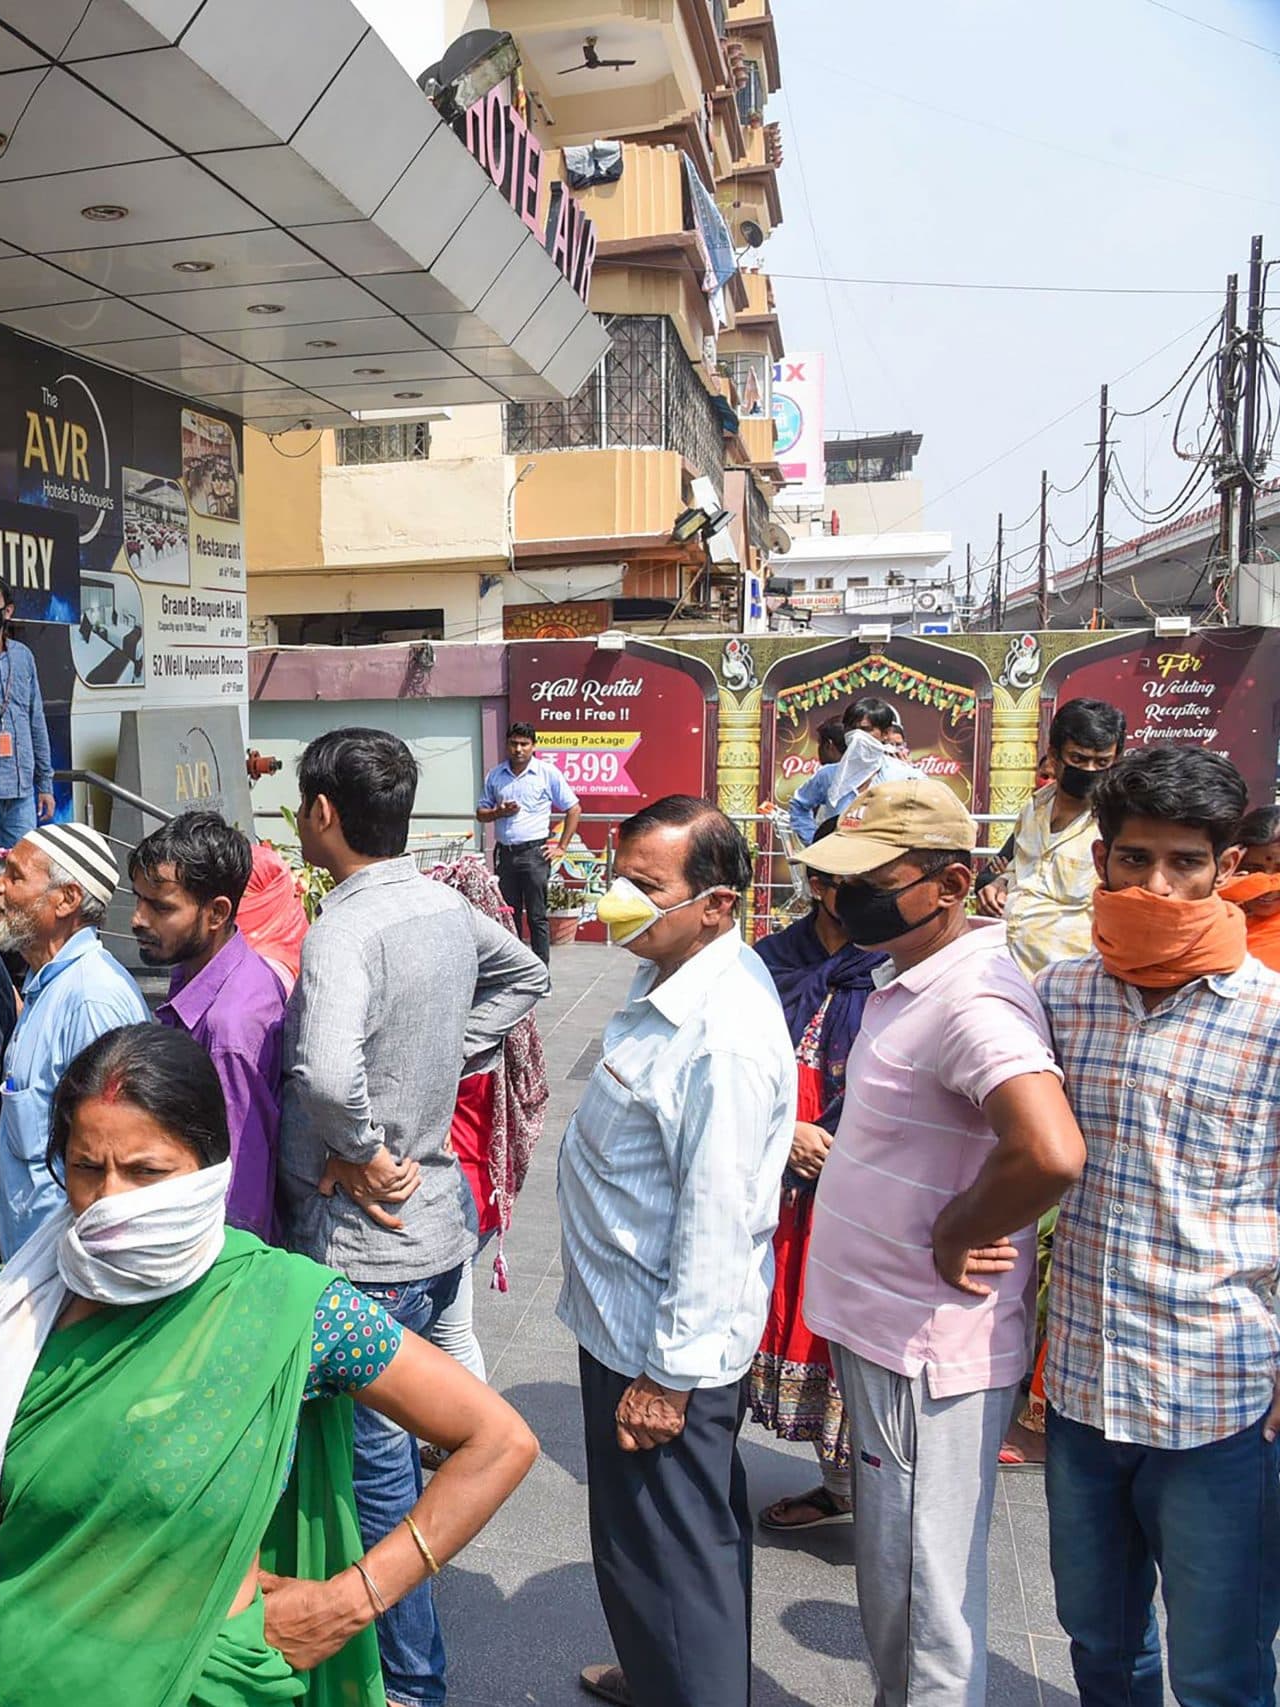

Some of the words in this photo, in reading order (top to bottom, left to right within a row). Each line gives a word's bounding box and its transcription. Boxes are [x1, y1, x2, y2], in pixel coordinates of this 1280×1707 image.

[41, 386, 59, 408] The
[23, 410, 91, 483] AVR
[42, 480, 70, 501] Hotels
[70, 485, 78, 502] &
[79, 487, 115, 510] Banquets
[196, 533, 241, 560] Restaurant
[162, 594, 189, 615] Grand
[191, 596, 224, 621] Banquet
[226, 600, 242, 618] Hall
[153, 654, 163, 677] 52
[163, 654, 183, 676] Well
[184, 655, 219, 681] Appointed
[221, 655, 243, 675] Rooms
[1157, 653, 1202, 678] For
[530, 677, 578, 702] Hall
[581, 677, 643, 706] Rental
[1142, 680, 1217, 698] Wedding
[540, 708, 571, 720] Free
[584, 708, 616, 720] Free
[620, 707, 630, 720] !!
[1145, 702, 1210, 722] Reception
[581, 735, 625, 747] Package
[1134, 725, 1218, 744] Anniversary
[564, 752, 619, 783] 599
[175, 762, 212, 802] AVR
[590, 784, 629, 793] onwards
